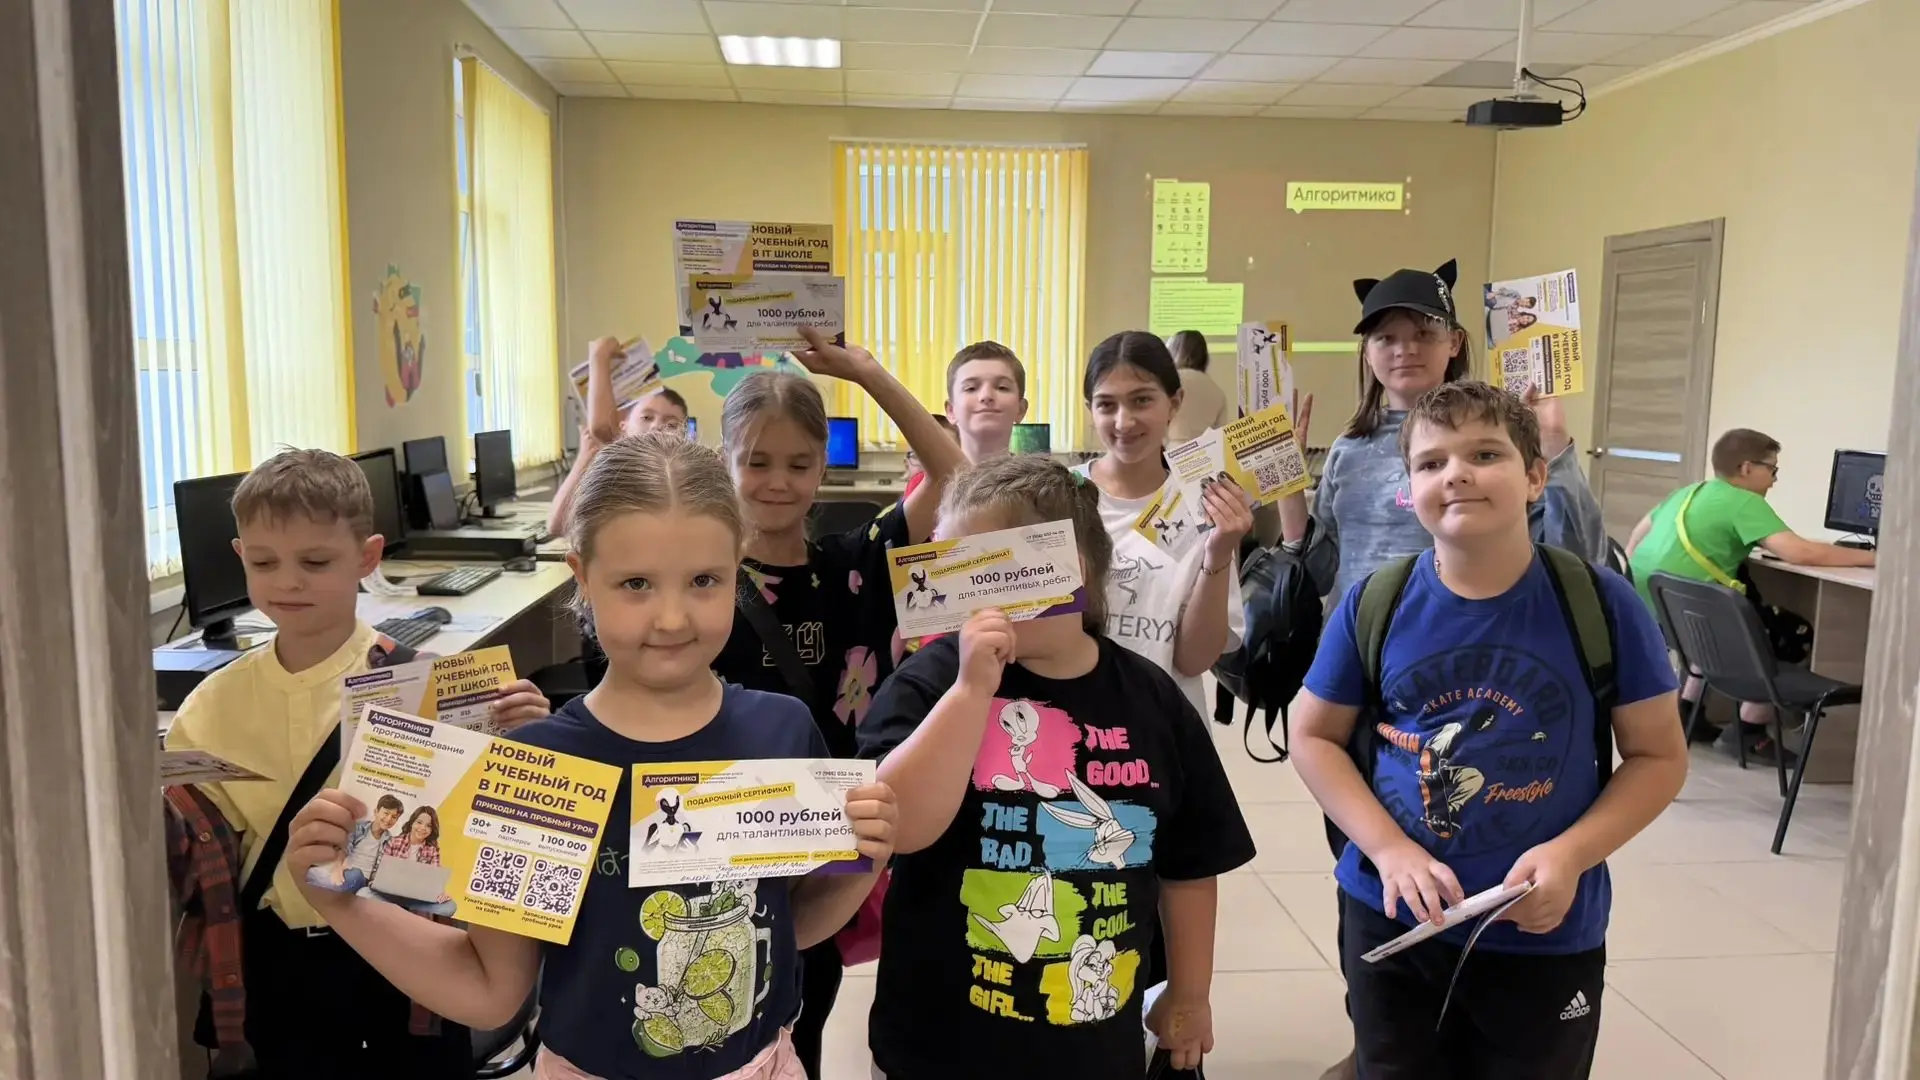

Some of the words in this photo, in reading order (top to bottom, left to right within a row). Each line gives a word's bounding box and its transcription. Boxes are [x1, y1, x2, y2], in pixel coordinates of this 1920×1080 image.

[1293, 187, 1396, 205] Алгоритмика
[752, 224, 792, 235] НОВЫЙ
[752, 237, 805, 248] УЧЕБНЫЙ
[808, 239, 829, 249] ГОД
[753, 249, 759, 258] В
[762, 250, 772, 258] IT
[774, 250, 813, 259] ШКОЛЕ
[757, 308, 782, 318] 1000
[785, 308, 826, 319] рублей
[1562, 331, 1572, 373] УЧЕБНЫЙ
[1571, 330, 1580, 361] НОВЫЙ
[1564, 373, 1572, 391] ГОД
[1223, 416, 1255, 434] НОВЫЙ
[1227, 421, 1268, 442] УЧЕБНЫЙ
[1269, 414, 1287, 425] ГОД
[1247, 427, 1278, 444] ШКОЛЕ
[931, 561, 972, 577] ПОДАРОЧНЫЙ
[972, 551, 1010, 568] СЕРТИФИКАТ
[970, 571, 1000, 586] 1000
[1004, 562, 1055, 583] рублей
[958, 590, 976, 601] для
[977, 580, 1040, 598] талантливых
[1043, 576, 1072, 590] ребят
[434, 653, 475, 671] НОВЫЙ
[435, 663, 490, 684] УЧЕБНЫЙ
[490, 661, 511, 674] ГОД
[436, 688, 445, 697] В
[447, 685, 458, 695] IT
[460, 677, 500, 693] ШКОЛЕ
[1422, 688, 1462, 715] SKATE
[1467, 687, 1524, 717] ACADEMY
[371, 712, 430, 734] Алгоритмика
[372, 726, 465, 755] программирование
[1085, 723, 1130, 752] THE
[489, 742, 556, 769] НОВЫЙ
[484, 760, 571, 792] УЧЕБНЫЙ
[573, 782, 608, 803] ГОД
[645, 774, 697, 785] Алгоритмика
[478, 778, 490, 791] В
[493, 782, 511, 795] IT
[513, 787, 578, 812] ШКОЛЕ
[686, 792, 742, 807] ПОДАРОЧНЫЙ
[743, 785, 792, 799] СЕРТИФИКАТ
[1484, 777, 1554, 805] Freestyle
[471, 817, 492, 828] 90+
[475, 800, 516, 815] ПРИХОДИ
[516, 810, 529, 819] НА
[530, 813, 572, 829] ПРОБНЫЙ
[571, 823, 595, 834] УРОК
[736, 810, 774, 824] 1000
[779, 808, 842, 826] рублей
[981, 802, 1029, 832] THE
[500, 824, 517, 835] 515
[716, 831, 740, 842] для
[743, 828, 821, 841] талантливых
[824, 824, 856, 841] ребя
[566, 839, 588, 852] 000
[1091, 882, 1128, 909] THE
[971, 954, 1014, 986] THE
[1560, 1005, 1591, 1020] adidas
